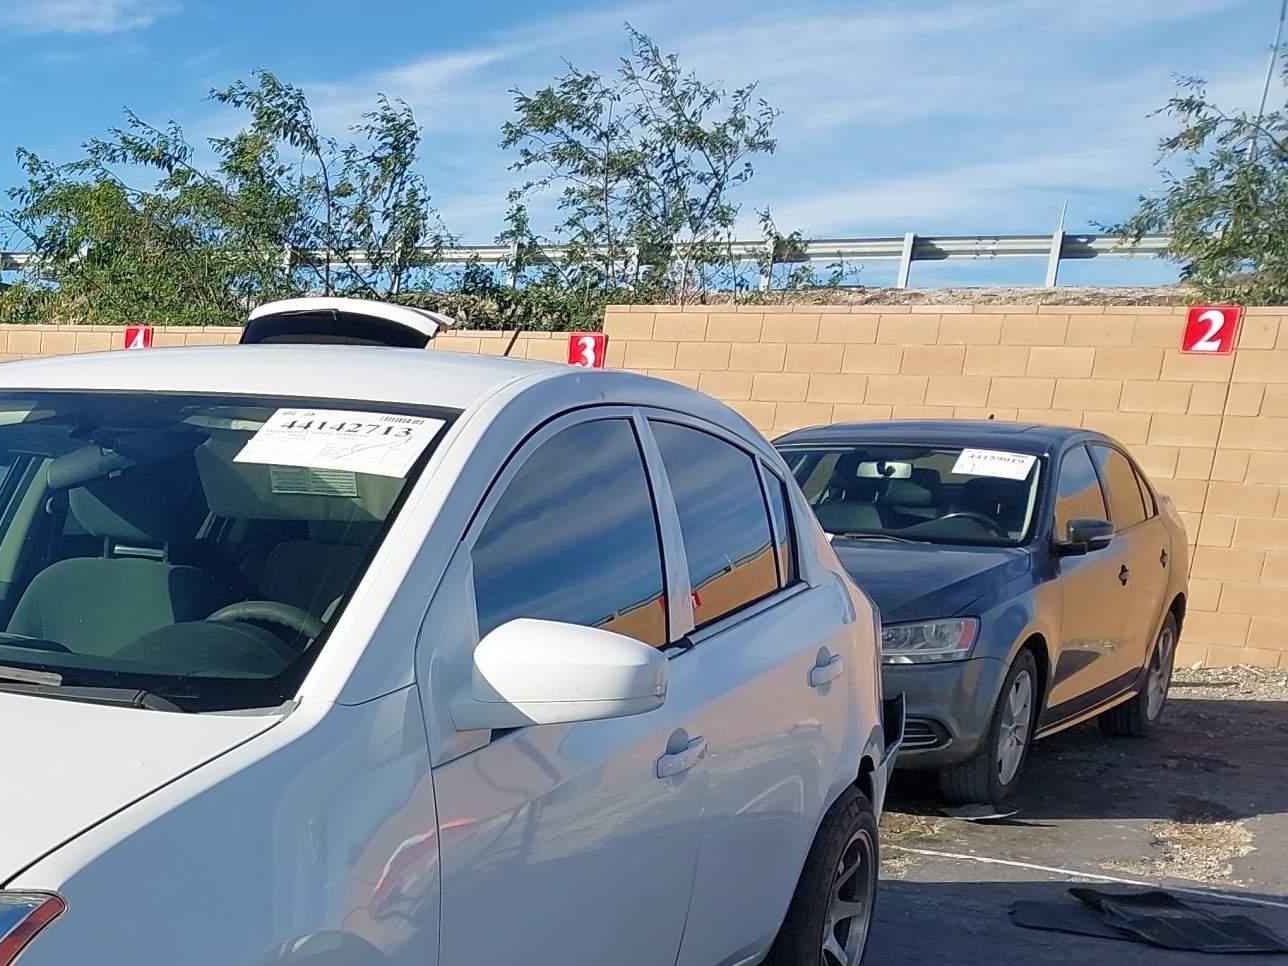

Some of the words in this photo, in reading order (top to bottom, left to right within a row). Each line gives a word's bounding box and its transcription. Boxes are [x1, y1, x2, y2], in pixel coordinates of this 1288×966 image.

[129, 328, 145, 350] 4
[1191, 309, 1225, 351] 2
[577, 336, 596, 368] 3
[280, 419, 414, 438] 44142713
